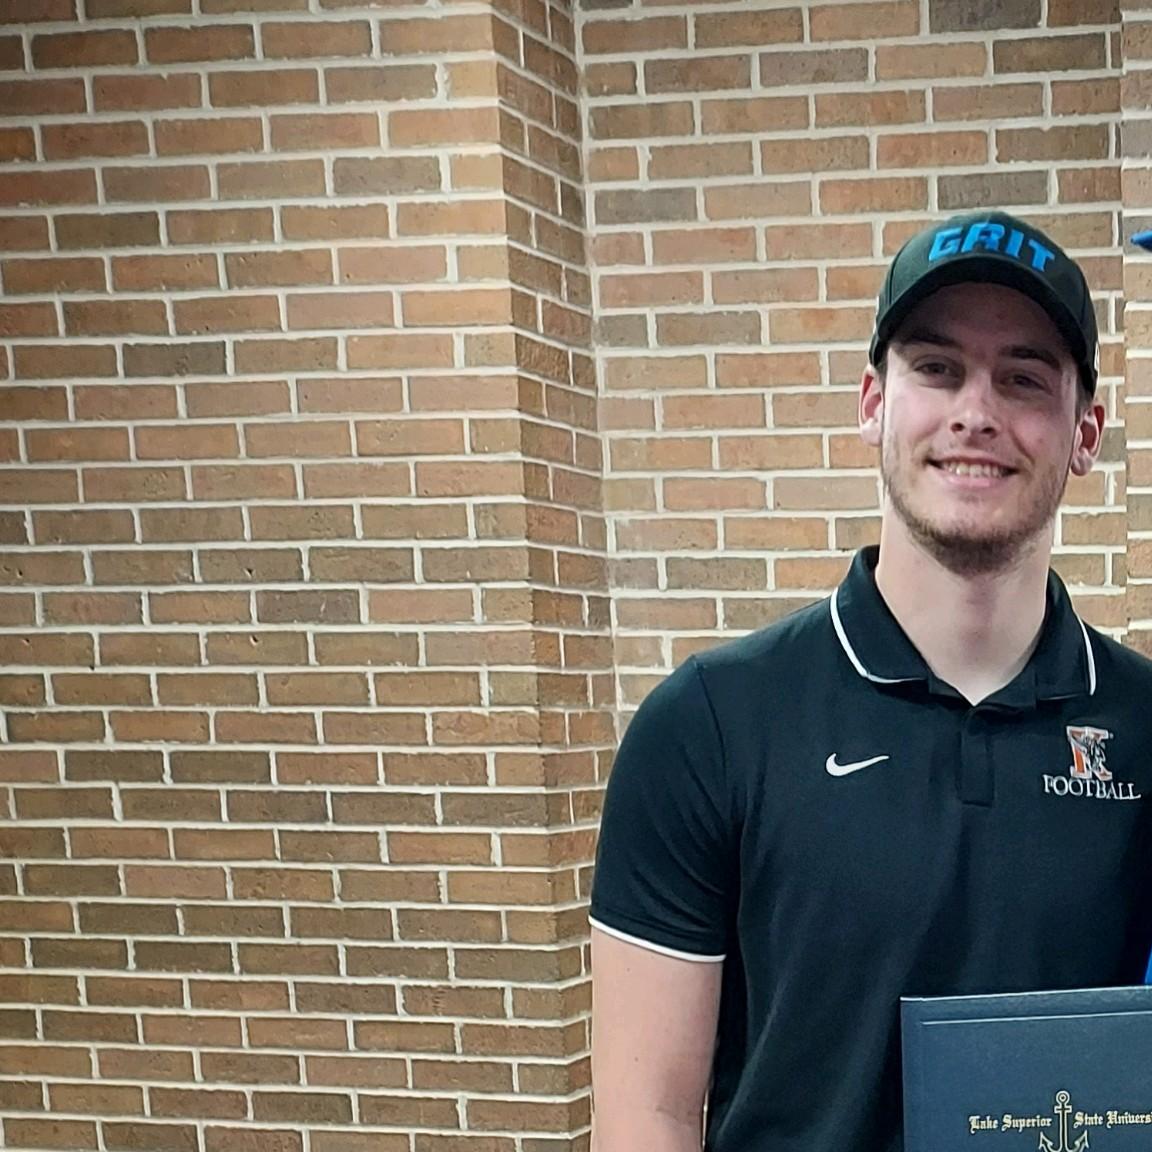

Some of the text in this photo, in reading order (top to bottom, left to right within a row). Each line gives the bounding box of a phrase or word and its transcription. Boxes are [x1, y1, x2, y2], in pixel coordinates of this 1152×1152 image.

[928, 221, 1056, 272] GRIT
[1042, 774, 1141, 800] FOOTBALL
[968, 1115, 998, 1134] Lake
[1001, 1114, 1052, 1133] Superior
[1073, 1111, 1103, 1128] State
